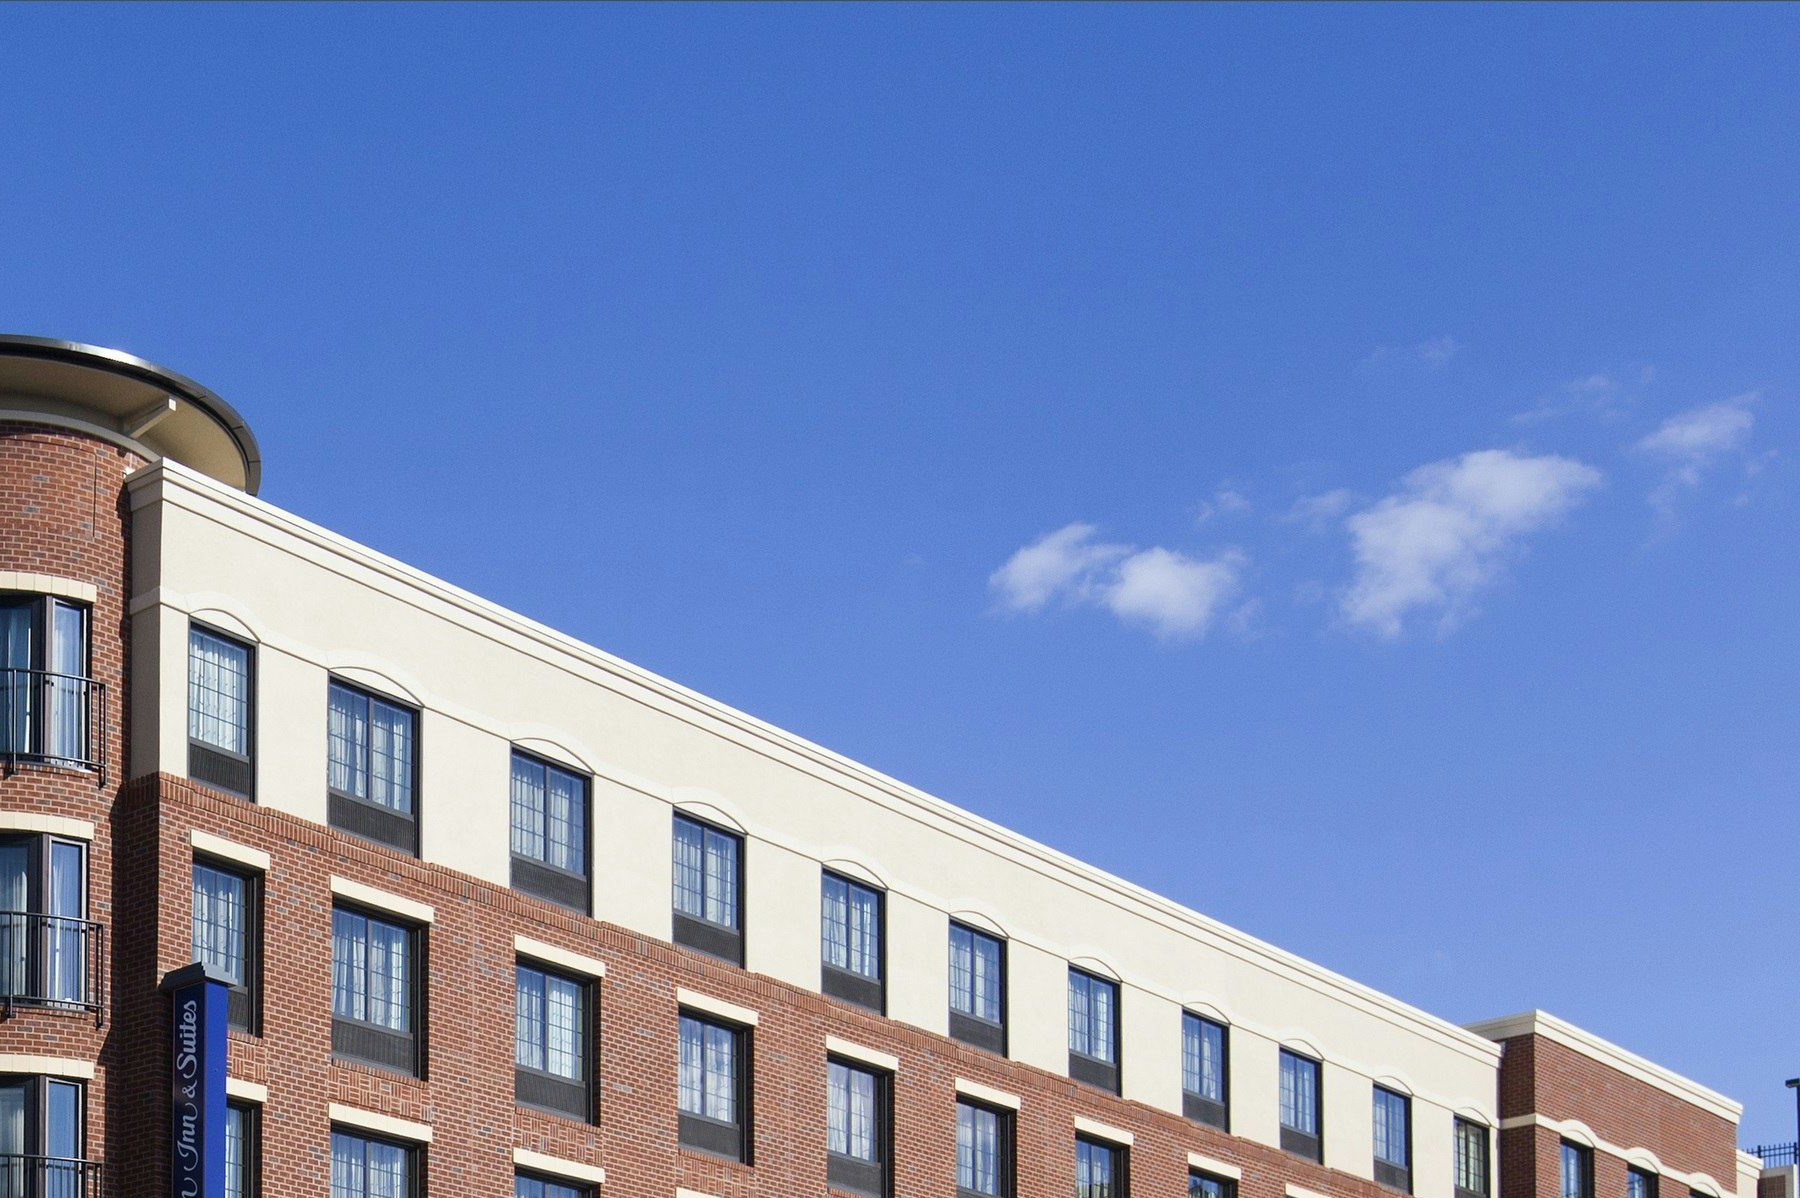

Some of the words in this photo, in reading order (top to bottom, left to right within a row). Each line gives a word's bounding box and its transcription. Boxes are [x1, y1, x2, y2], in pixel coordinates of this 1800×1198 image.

[176, 1000, 197, 1079] Suites
[182, 1079, 198, 1099] &
[177, 1102, 199, 1171] Inn
